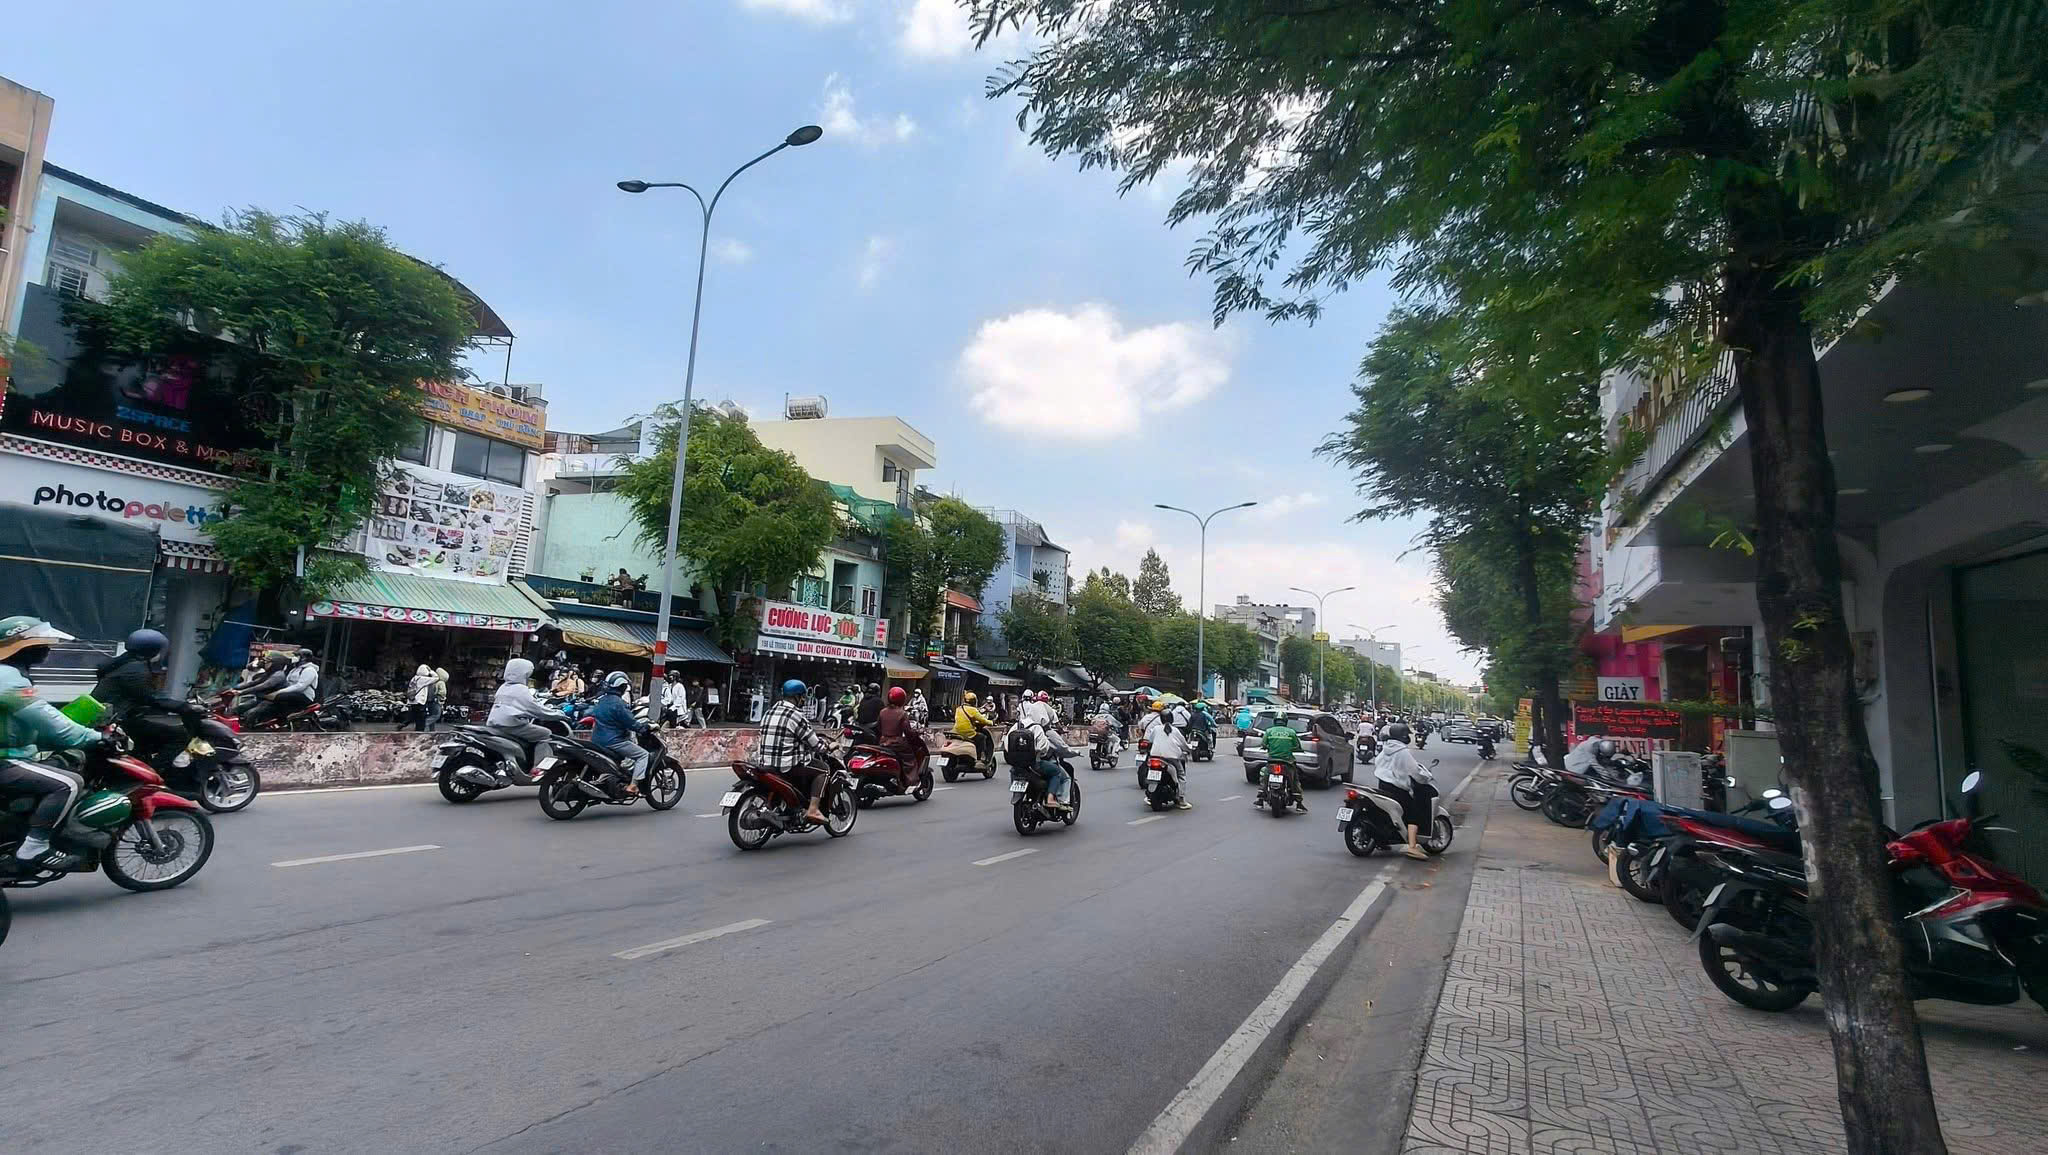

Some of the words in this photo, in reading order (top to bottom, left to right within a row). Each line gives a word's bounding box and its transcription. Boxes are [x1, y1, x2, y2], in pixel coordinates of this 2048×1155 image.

[32, 410, 113, 438] MUSIC
[121, 428, 167, 450] BOX
[176, 440, 189, 454] &
[811, 613, 832, 635] LỰC
[1604, 682, 1640, 700] GIÀY
